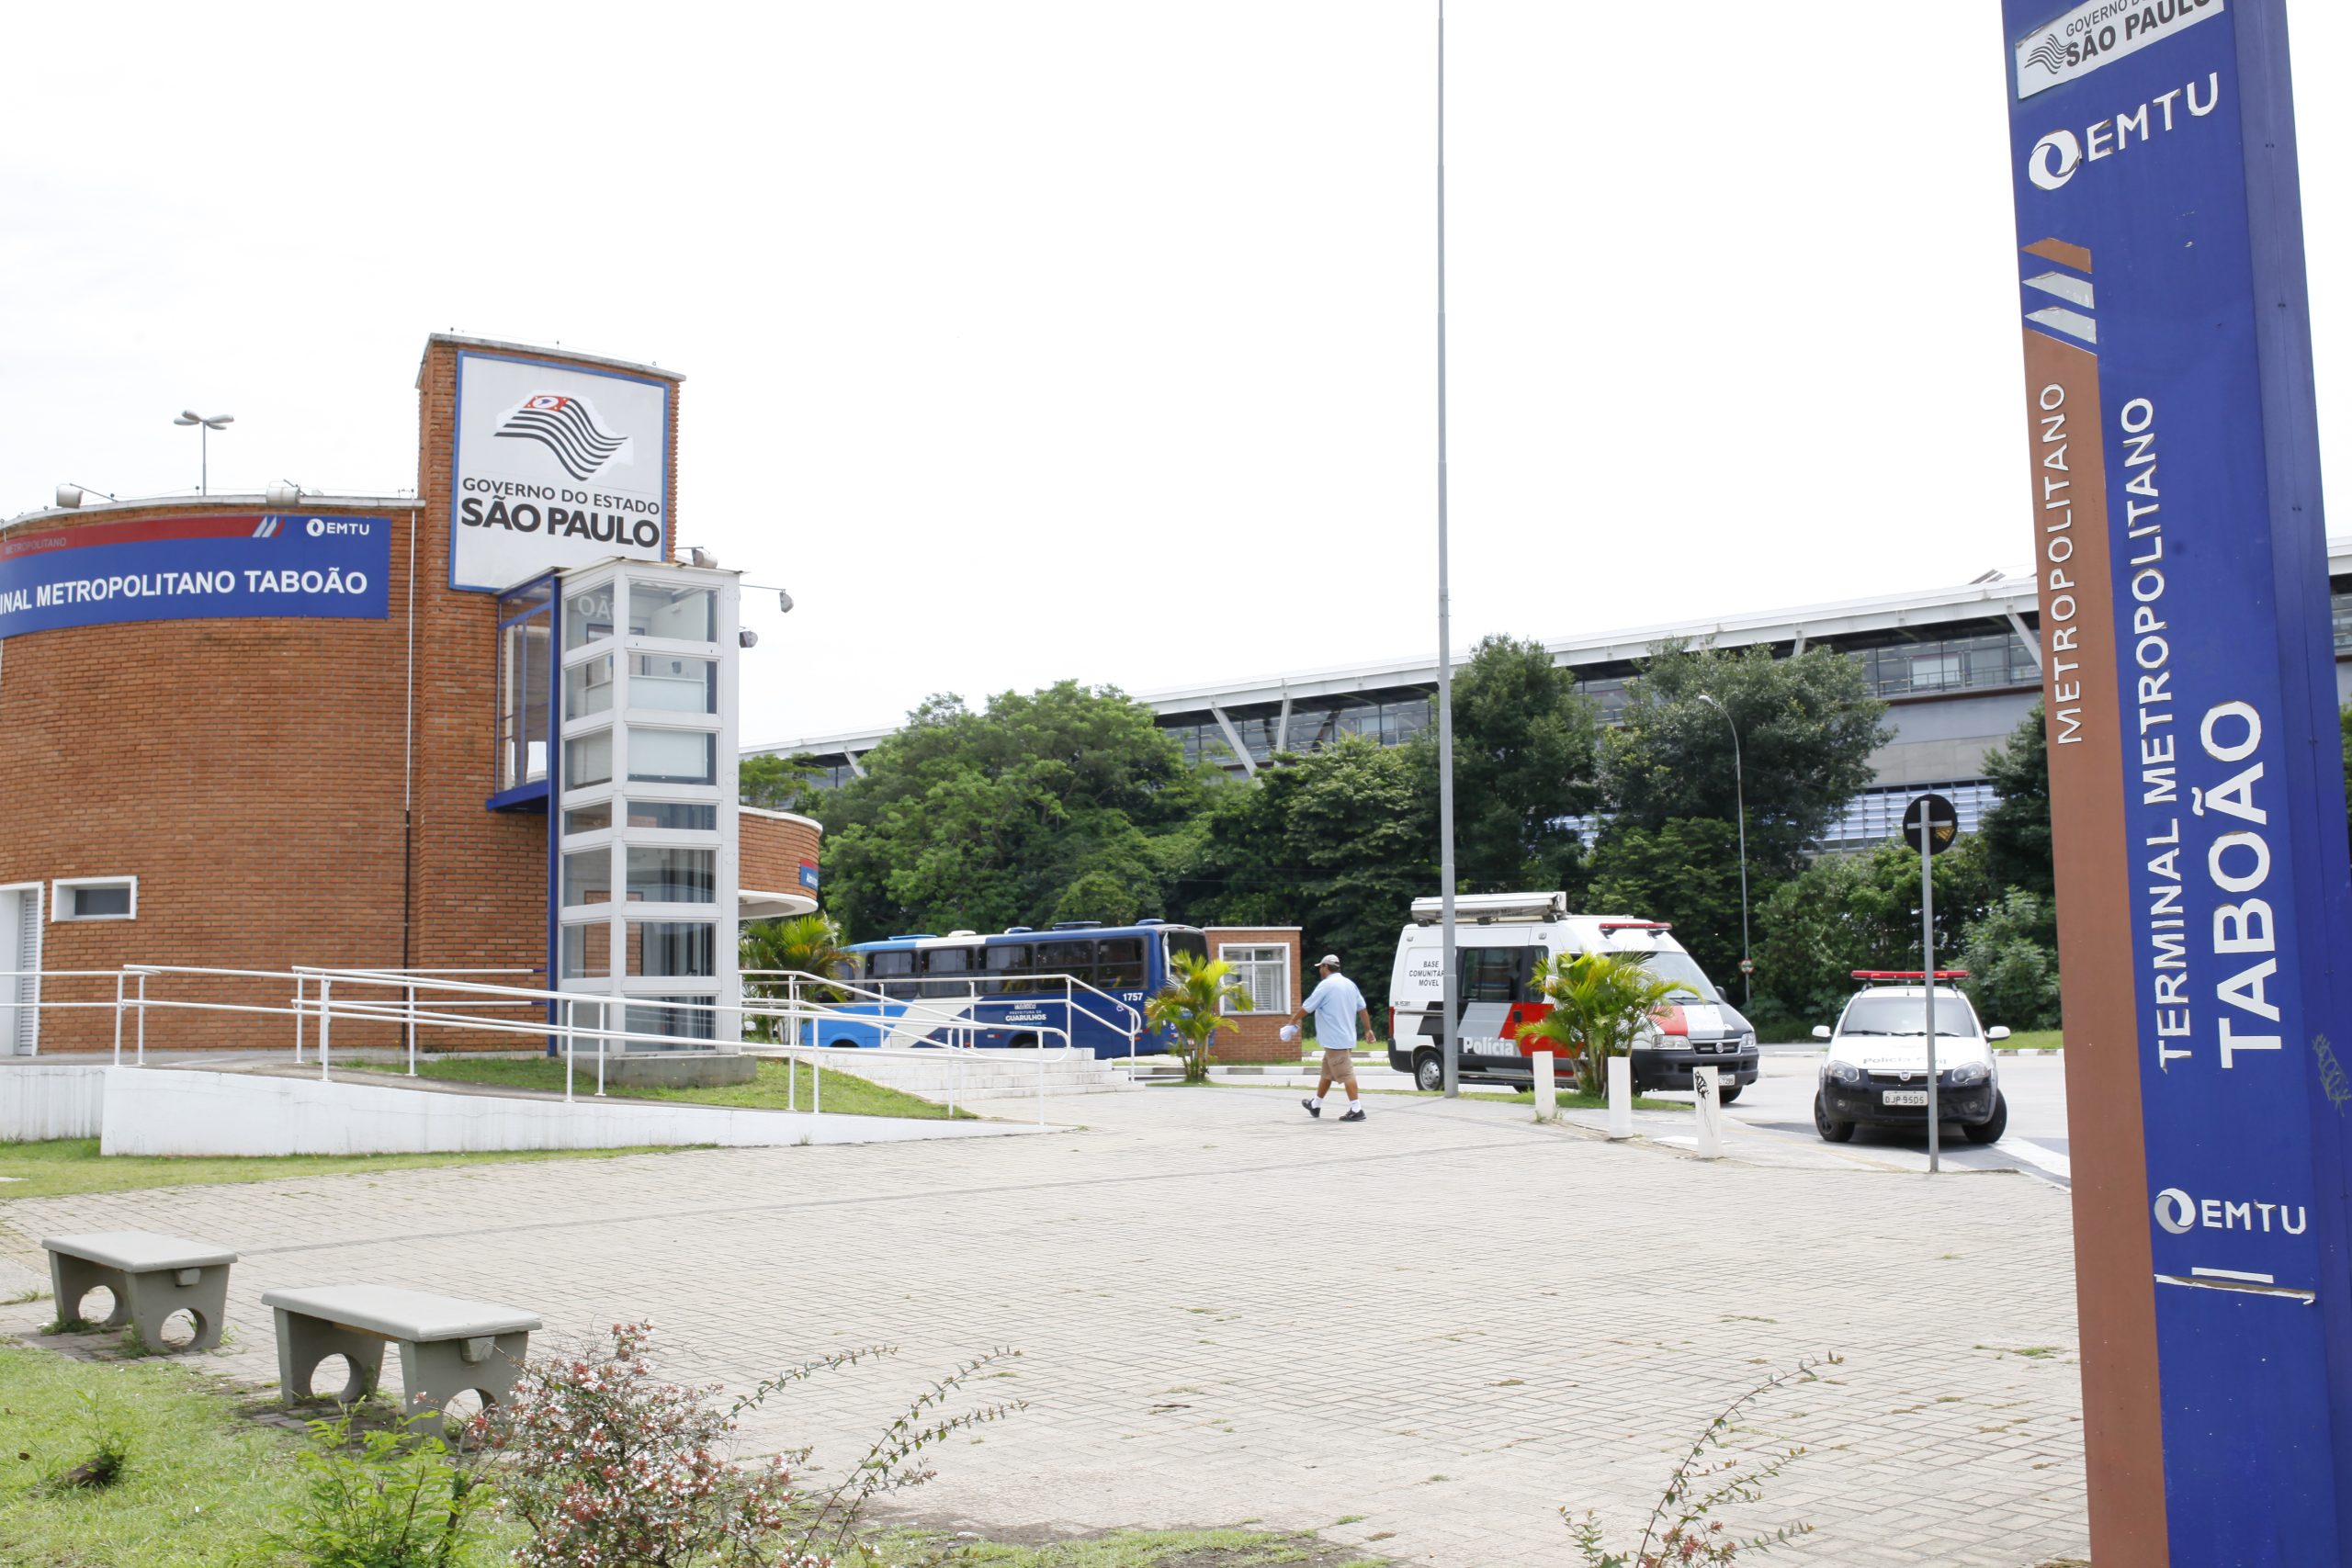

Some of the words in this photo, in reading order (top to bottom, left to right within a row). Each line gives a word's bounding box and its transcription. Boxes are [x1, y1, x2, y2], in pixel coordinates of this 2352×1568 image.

[2066, 0, 2128, 38] GOVERNO
[2067, 28, 2116, 67] SÃO
[2086, 72, 2218, 163] EMTU
[462, 478, 555, 501] GOVERNO
[561, 490, 588, 504] DO
[594, 493, 660, 515] ESTADO
[326, 522, 370, 536] EMTU
[461, 495, 541, 533] SÃO
[548, 507, 660, 548] PAULO
[2040, 383, 2084, 745] METROPOLITANO
[37, 570, 235, 607] METROPOLITANO
[244, 567, 368, 594] TABOÃO
[2120, 397, 2177, 806] METROPOLITANO
[2192, 700, 2282, 1069] TABOÃO
[2146, 818, 2192, 1073] TERMINAL
[1123, 992, 1144, 1001] 1757
[1463, 1037, 1514, 1056] Polícia
[2201, 1198, 2307, 1235] EMTU
